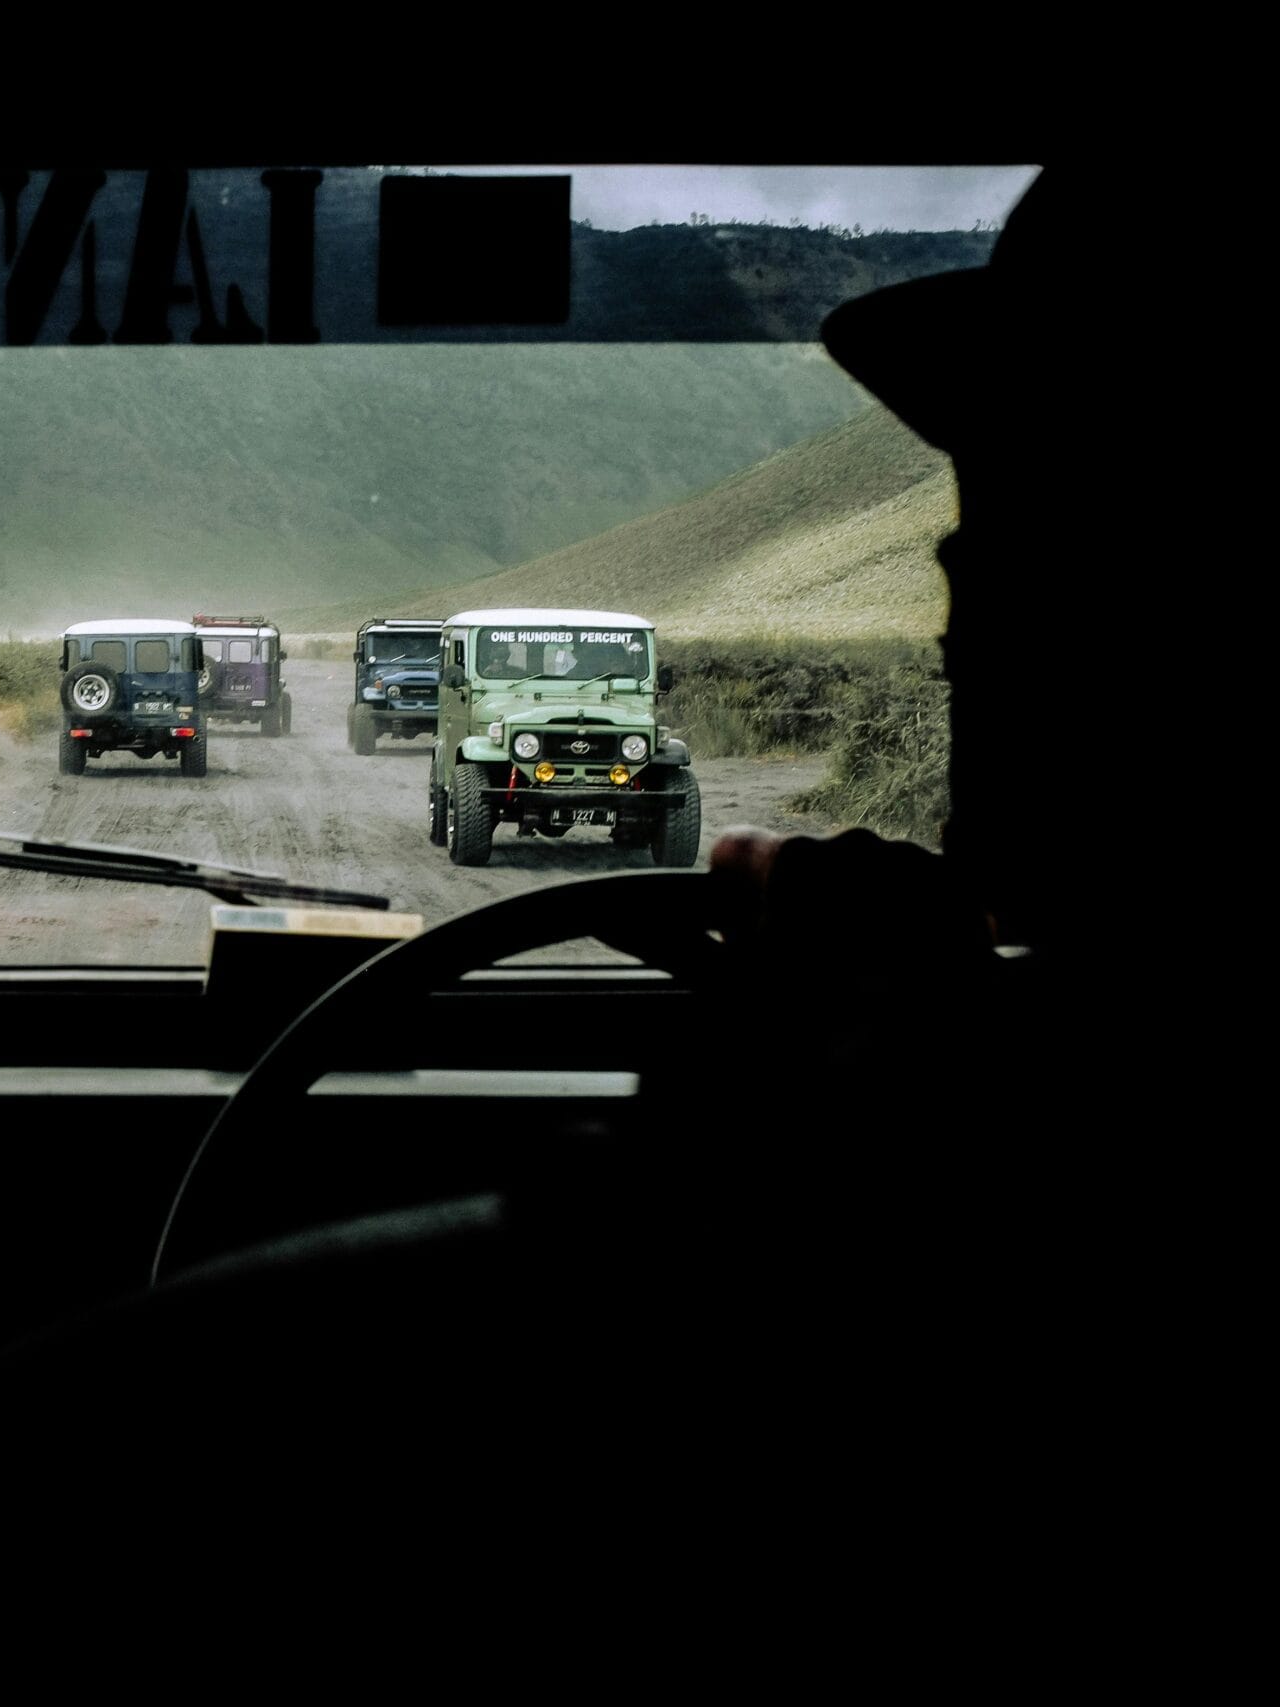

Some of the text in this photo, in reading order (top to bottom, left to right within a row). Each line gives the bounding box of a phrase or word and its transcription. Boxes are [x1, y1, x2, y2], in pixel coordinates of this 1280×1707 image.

[490, 631, 634, 644] ONE HUNDRED PERCENT
[573, 809, 596, 821] 1227
